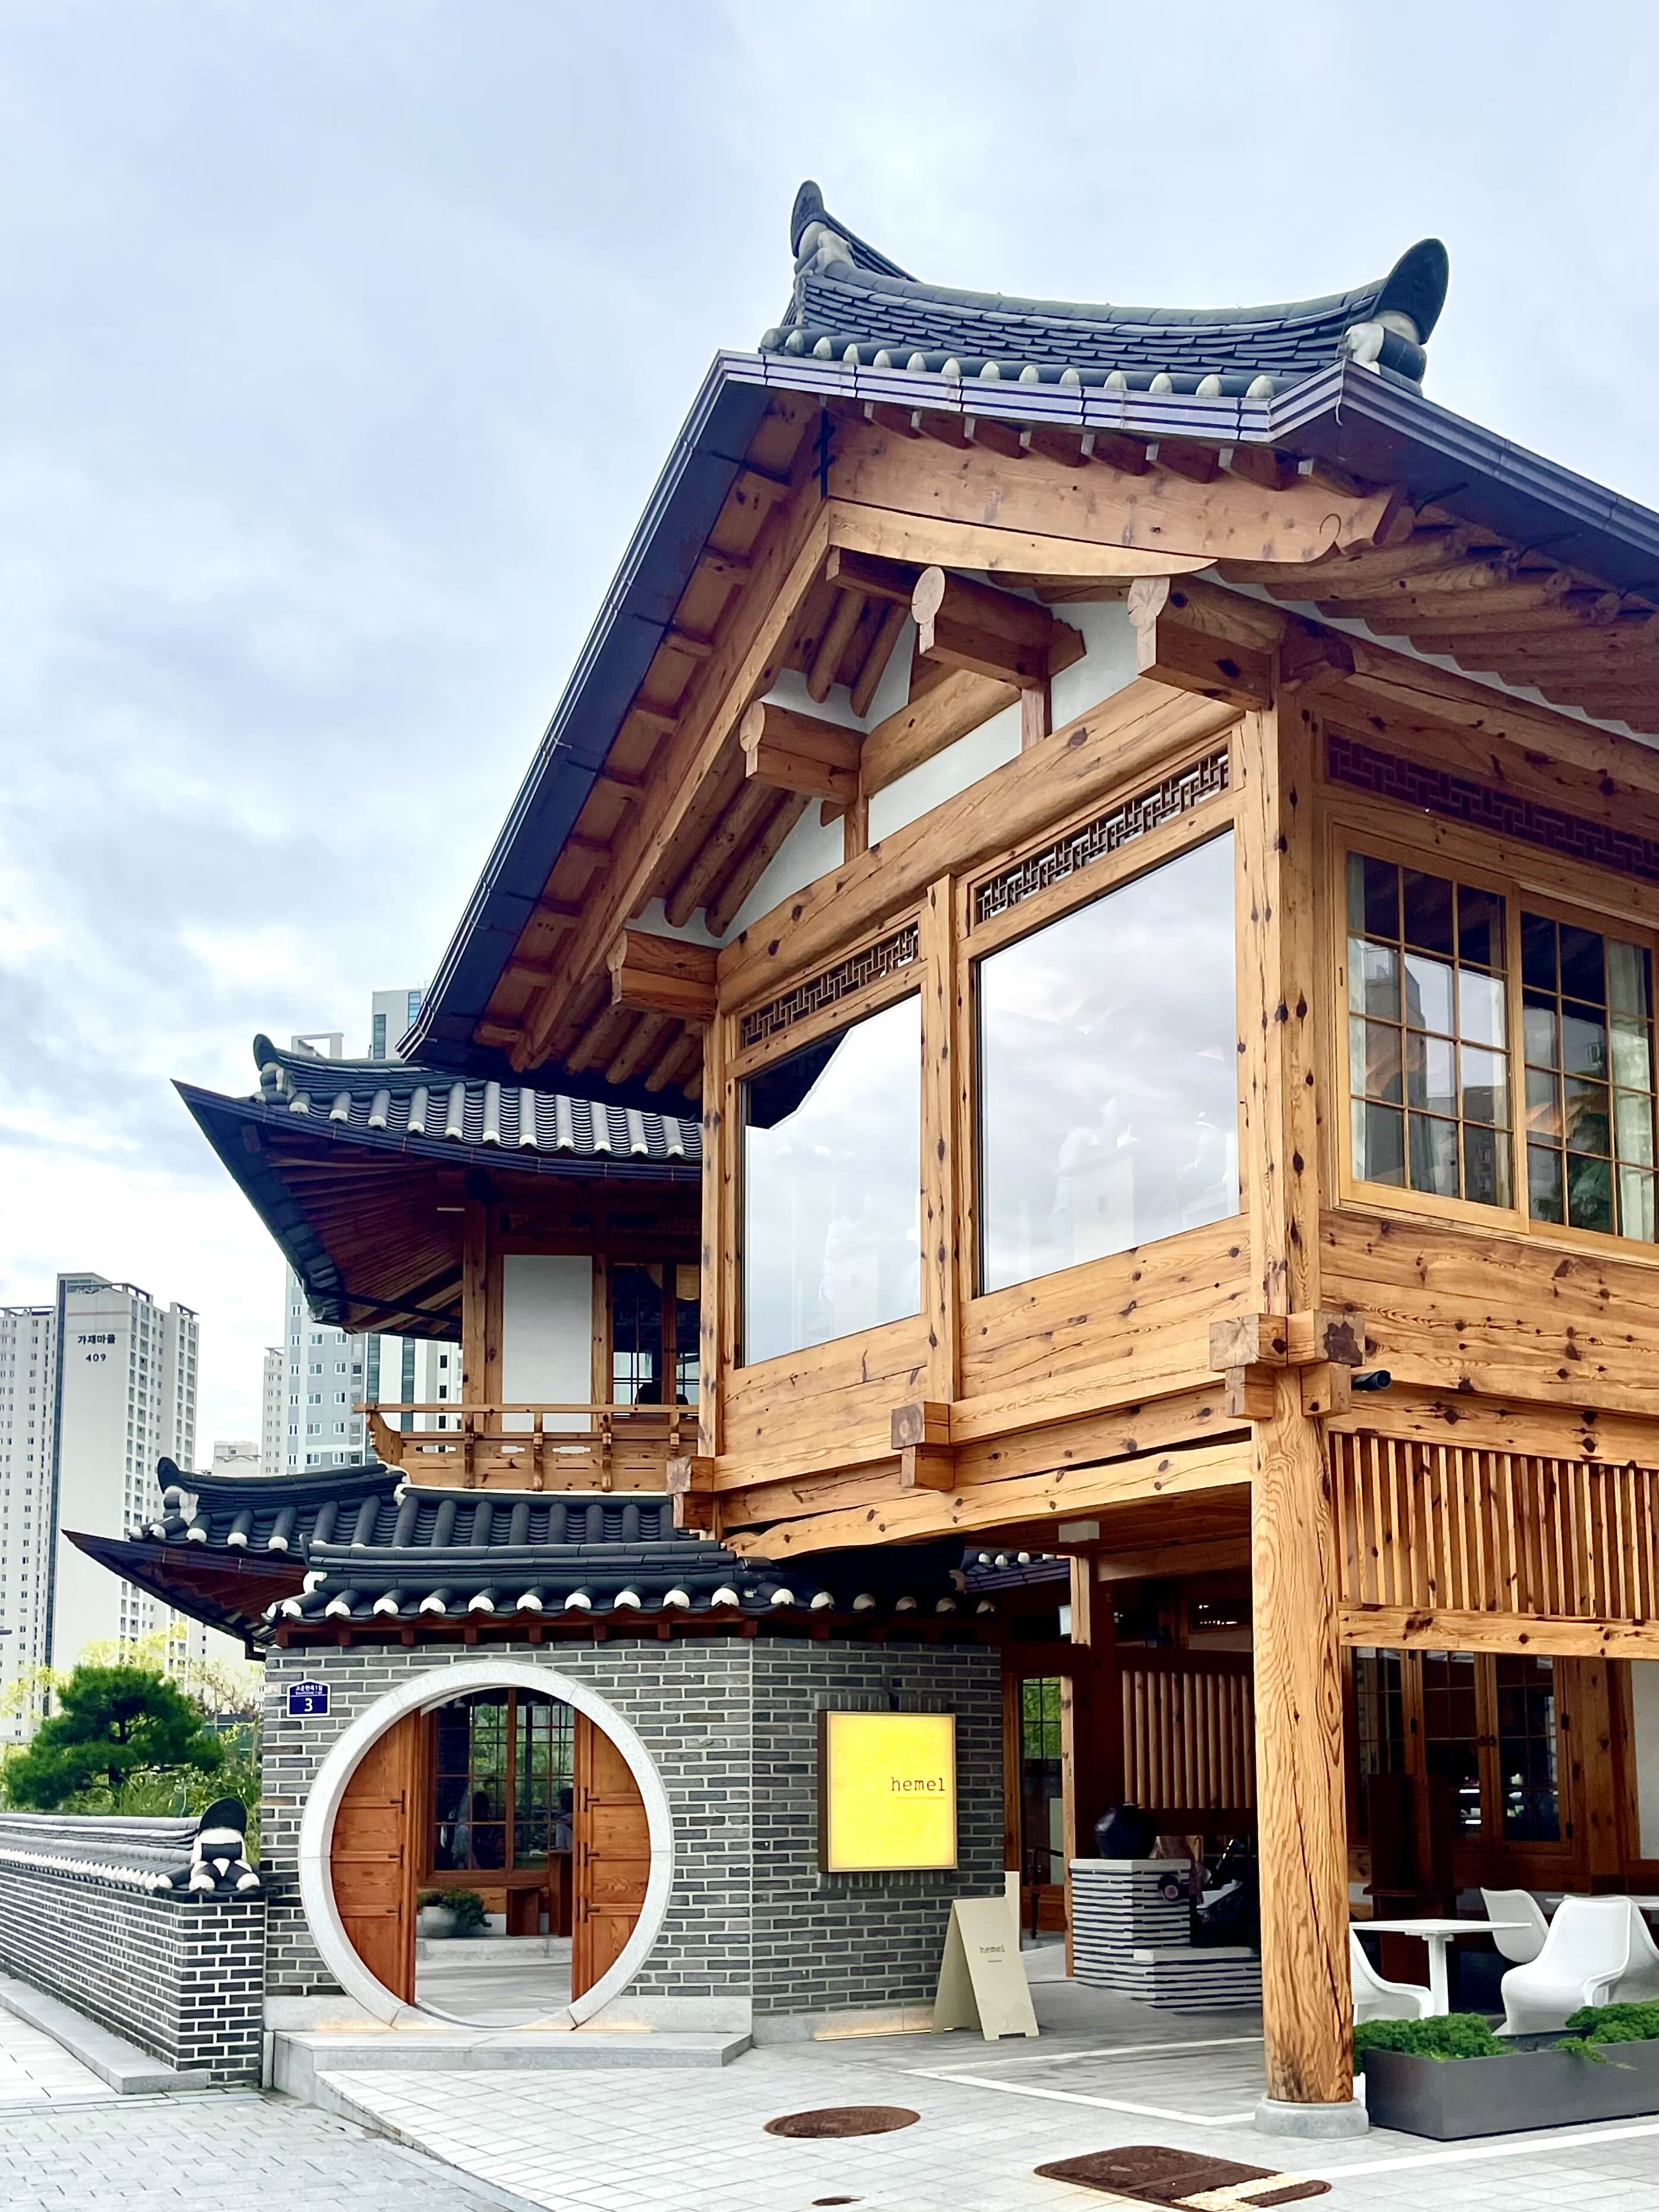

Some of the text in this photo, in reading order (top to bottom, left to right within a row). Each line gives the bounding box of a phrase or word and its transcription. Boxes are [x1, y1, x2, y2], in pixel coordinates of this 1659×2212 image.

[86, 1353, 106, 1362] 409
[304, 1698, 313, 1712] 3
[891, 1776, 945, 1791] hemel
